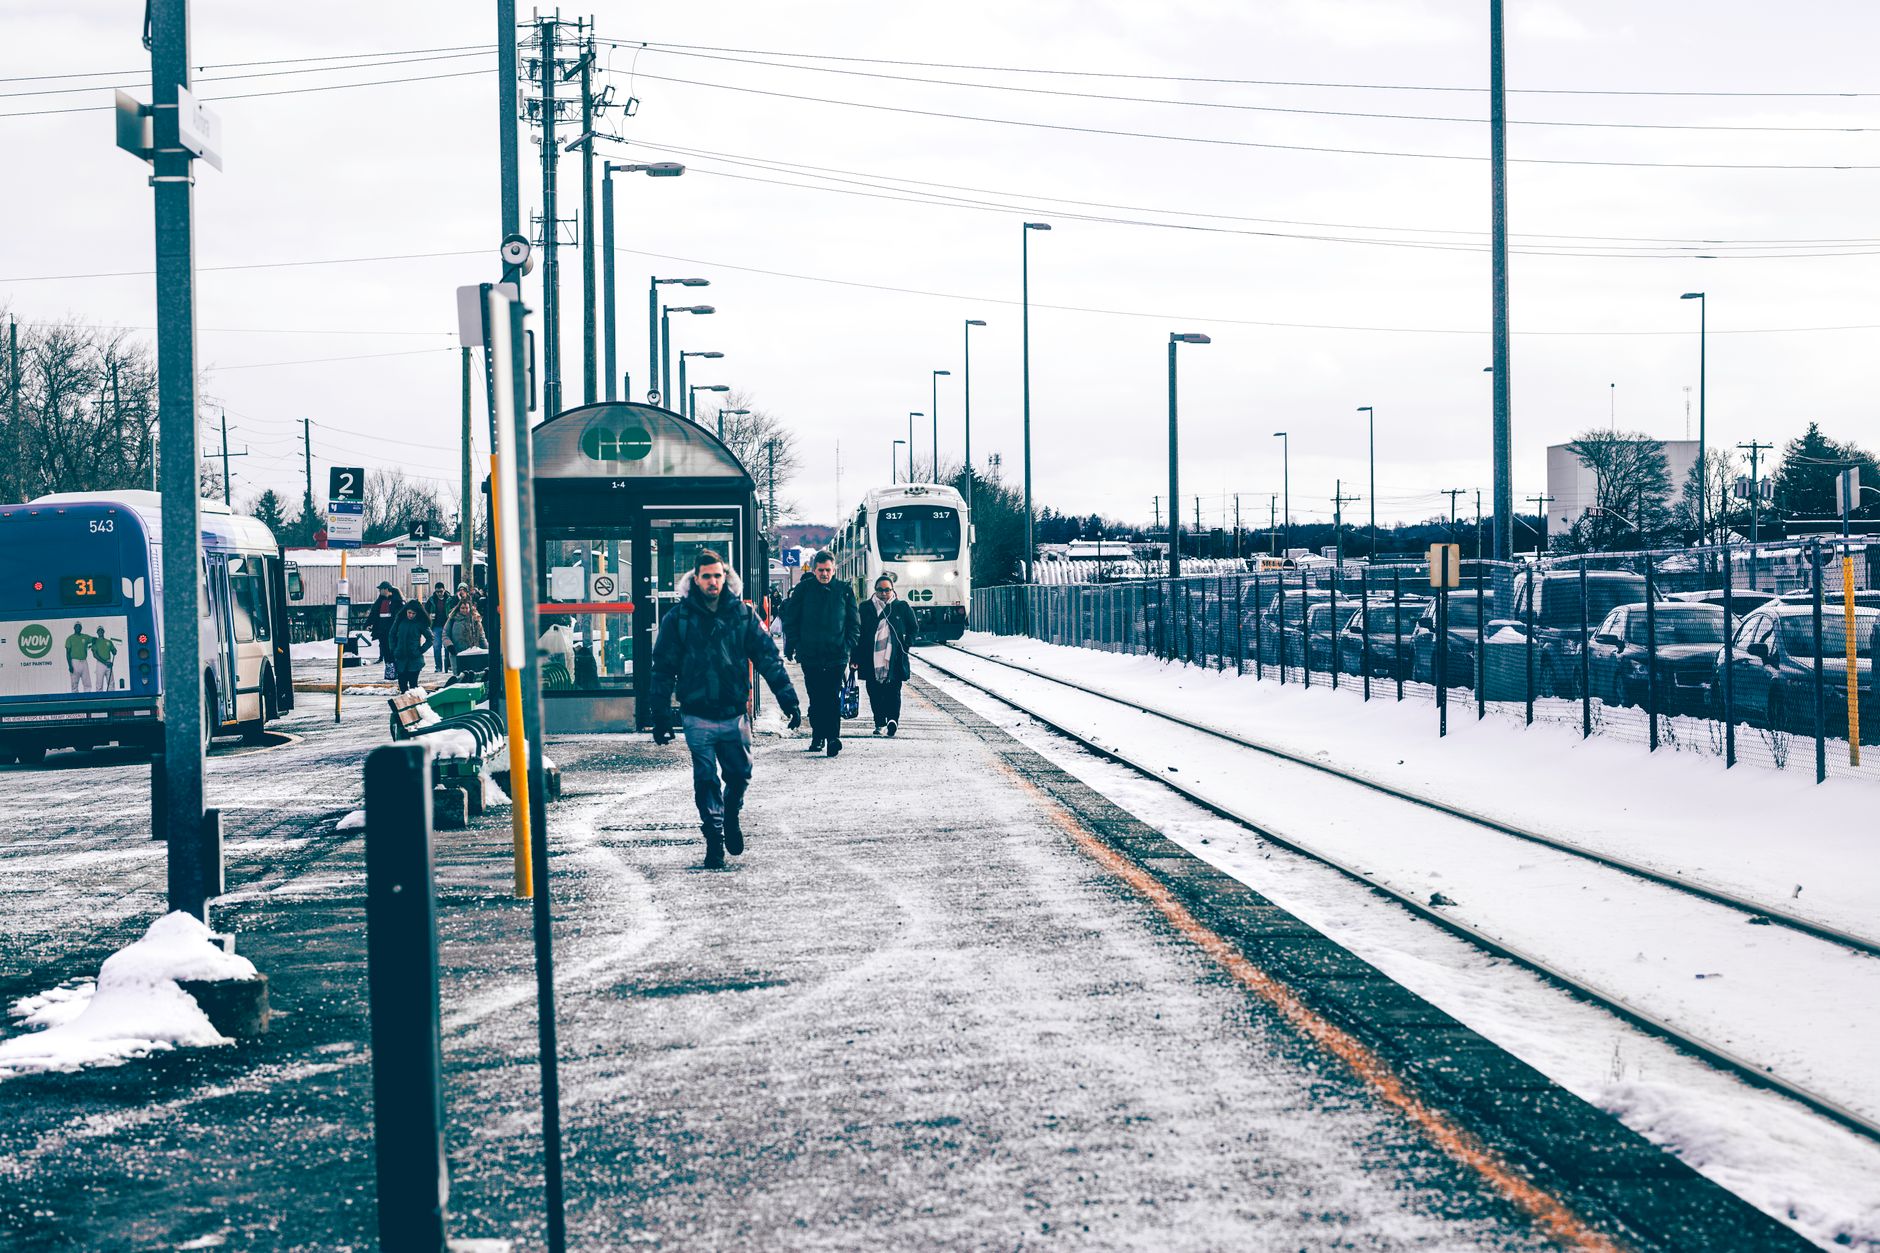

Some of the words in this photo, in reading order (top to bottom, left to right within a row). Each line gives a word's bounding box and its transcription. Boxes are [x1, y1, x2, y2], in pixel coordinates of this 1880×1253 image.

[339, 473, 354, 494] 2
[885, 512, 903, 520] 317
[932, 511, 950, 519] 317
[89, 519, 114, 533] 543
[414, 524, 425, 537] 4
[75, 578, 97, 596] 31
[21, 634, 50, 647] WOW
